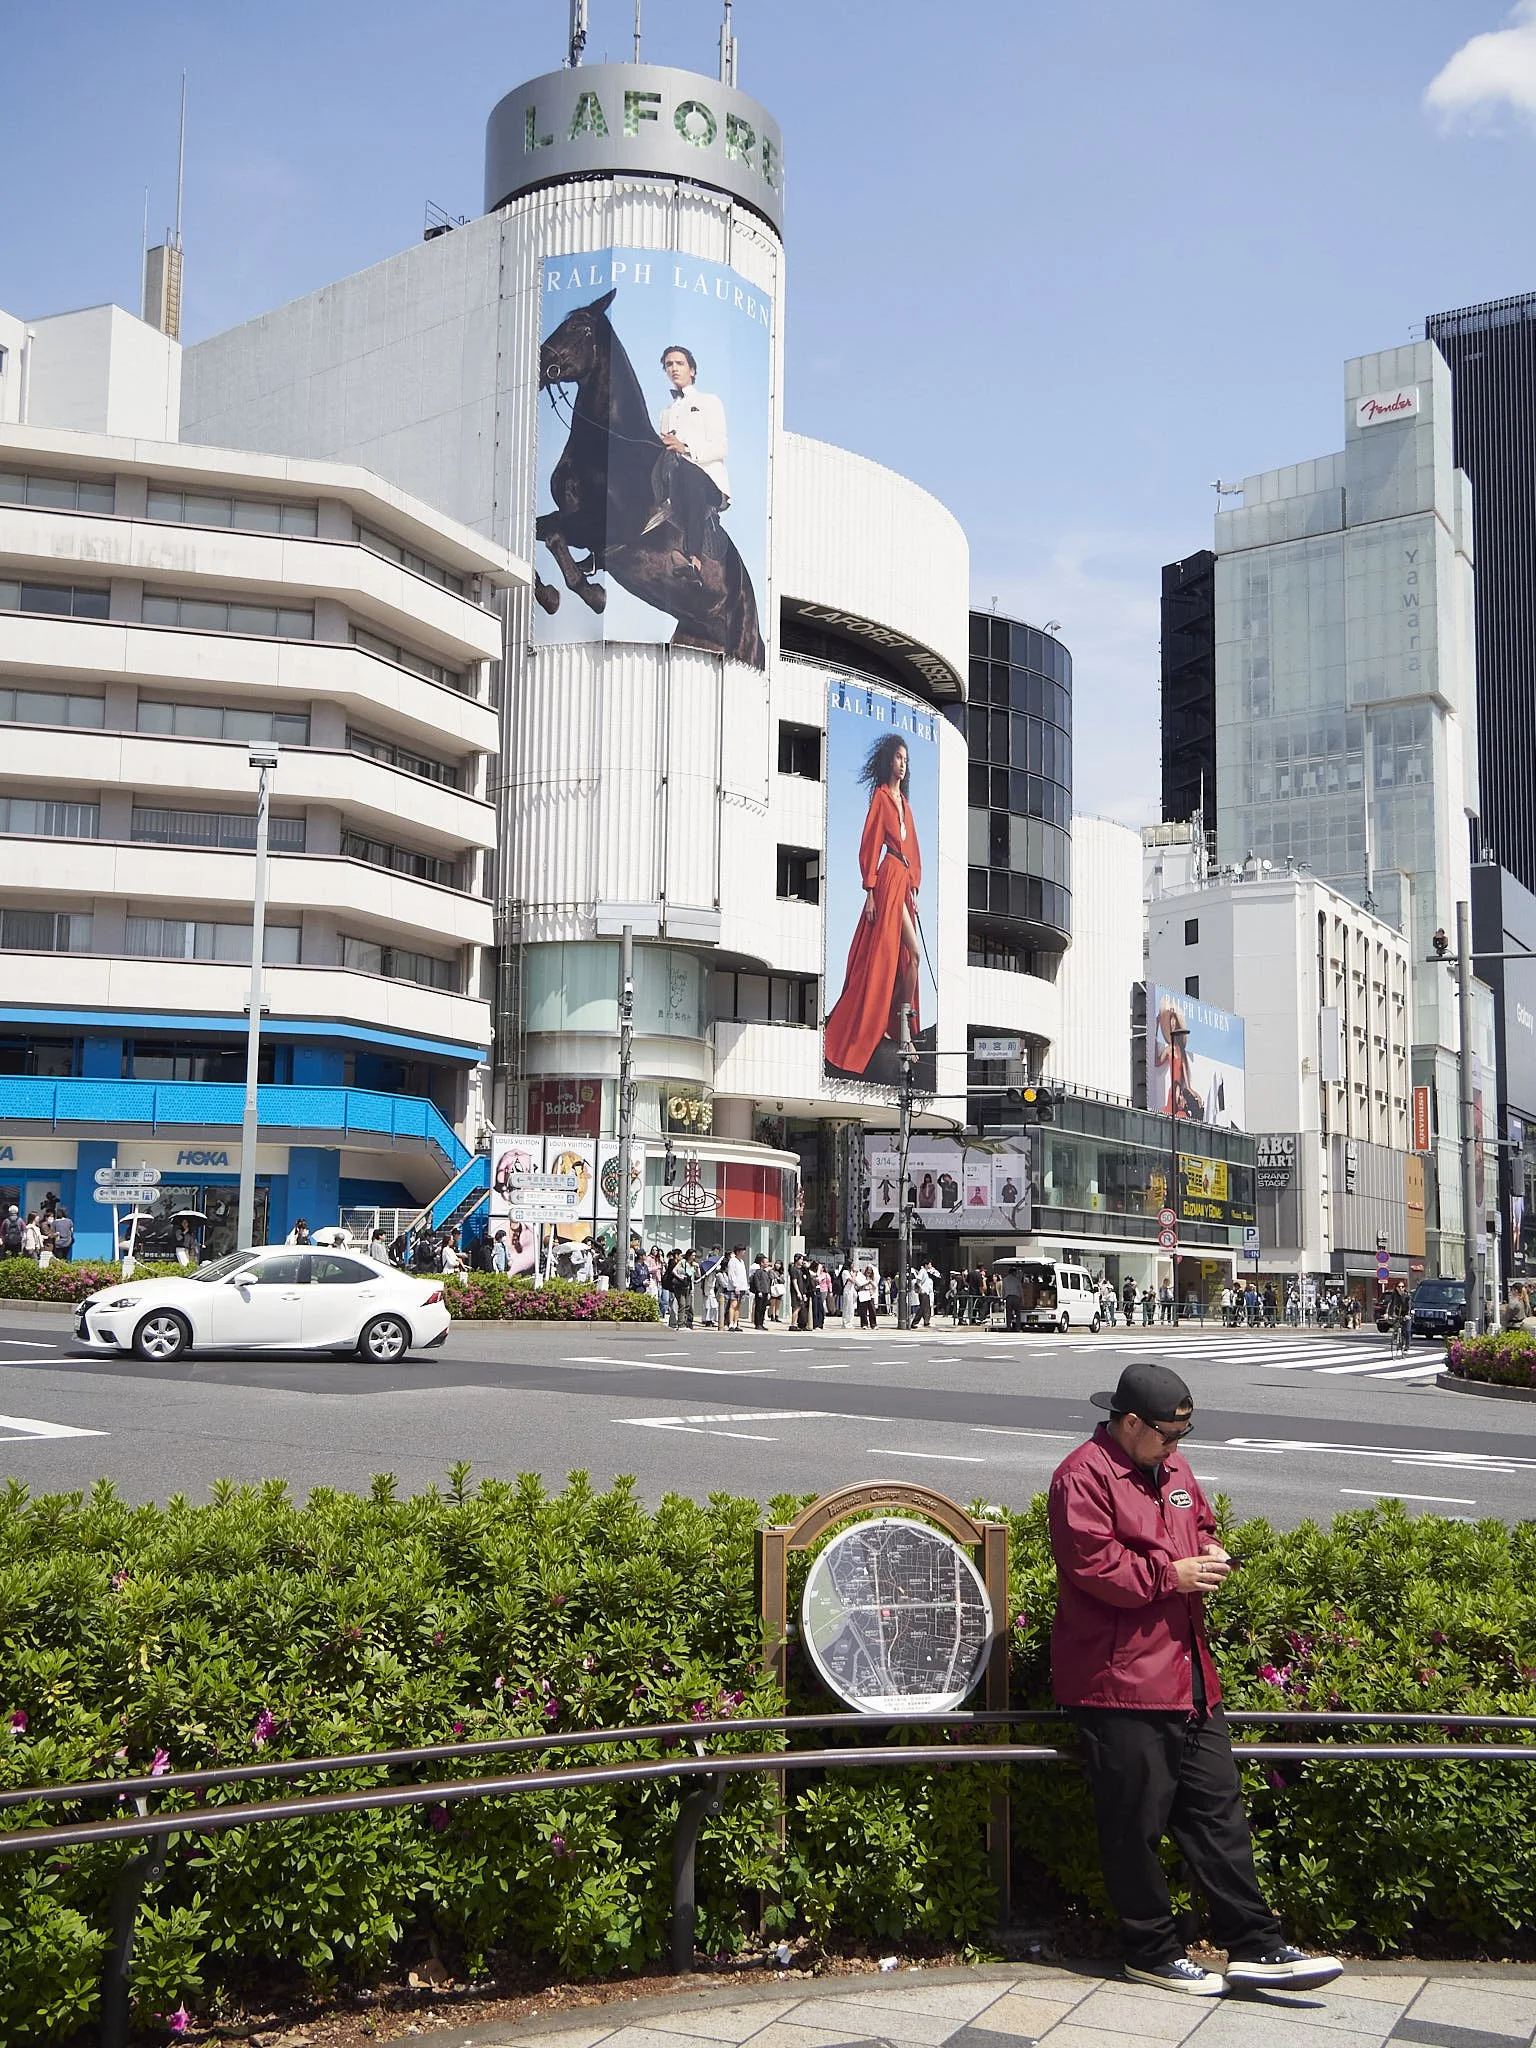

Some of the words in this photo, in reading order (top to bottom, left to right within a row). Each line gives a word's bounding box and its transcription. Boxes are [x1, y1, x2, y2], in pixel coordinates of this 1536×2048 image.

[548, 261, 652, 292] RALPH
[673, 265, 769, 329] LAUREN
[1360, 393, 1412, 420] Fender
[1403, 549, 1421, 672] Yawara
[797, 605, 915, 648] LAFORET
[904, 652, 957, 693] MUSEUM
[831, 692, 885, 722] RALPH
[1165, 994, 1194, 1019] RALPH
[1198, 1006, 1230, 1032] LAUREN
[1517, 1002, 1533, 1036] Galaxy
[545, 1101, 585, 1115] Baker
[569, 1141, 592, 1149] VUITTON
[1257, 1137, 1294, 1155] ABC
[176, 1150, 229, 1166] HOKA
[1257, 1155, 1294, 1167] MART
[1162, 1215, 1171, 1223] 50
[1247, 1228, 1255, 1240] P
